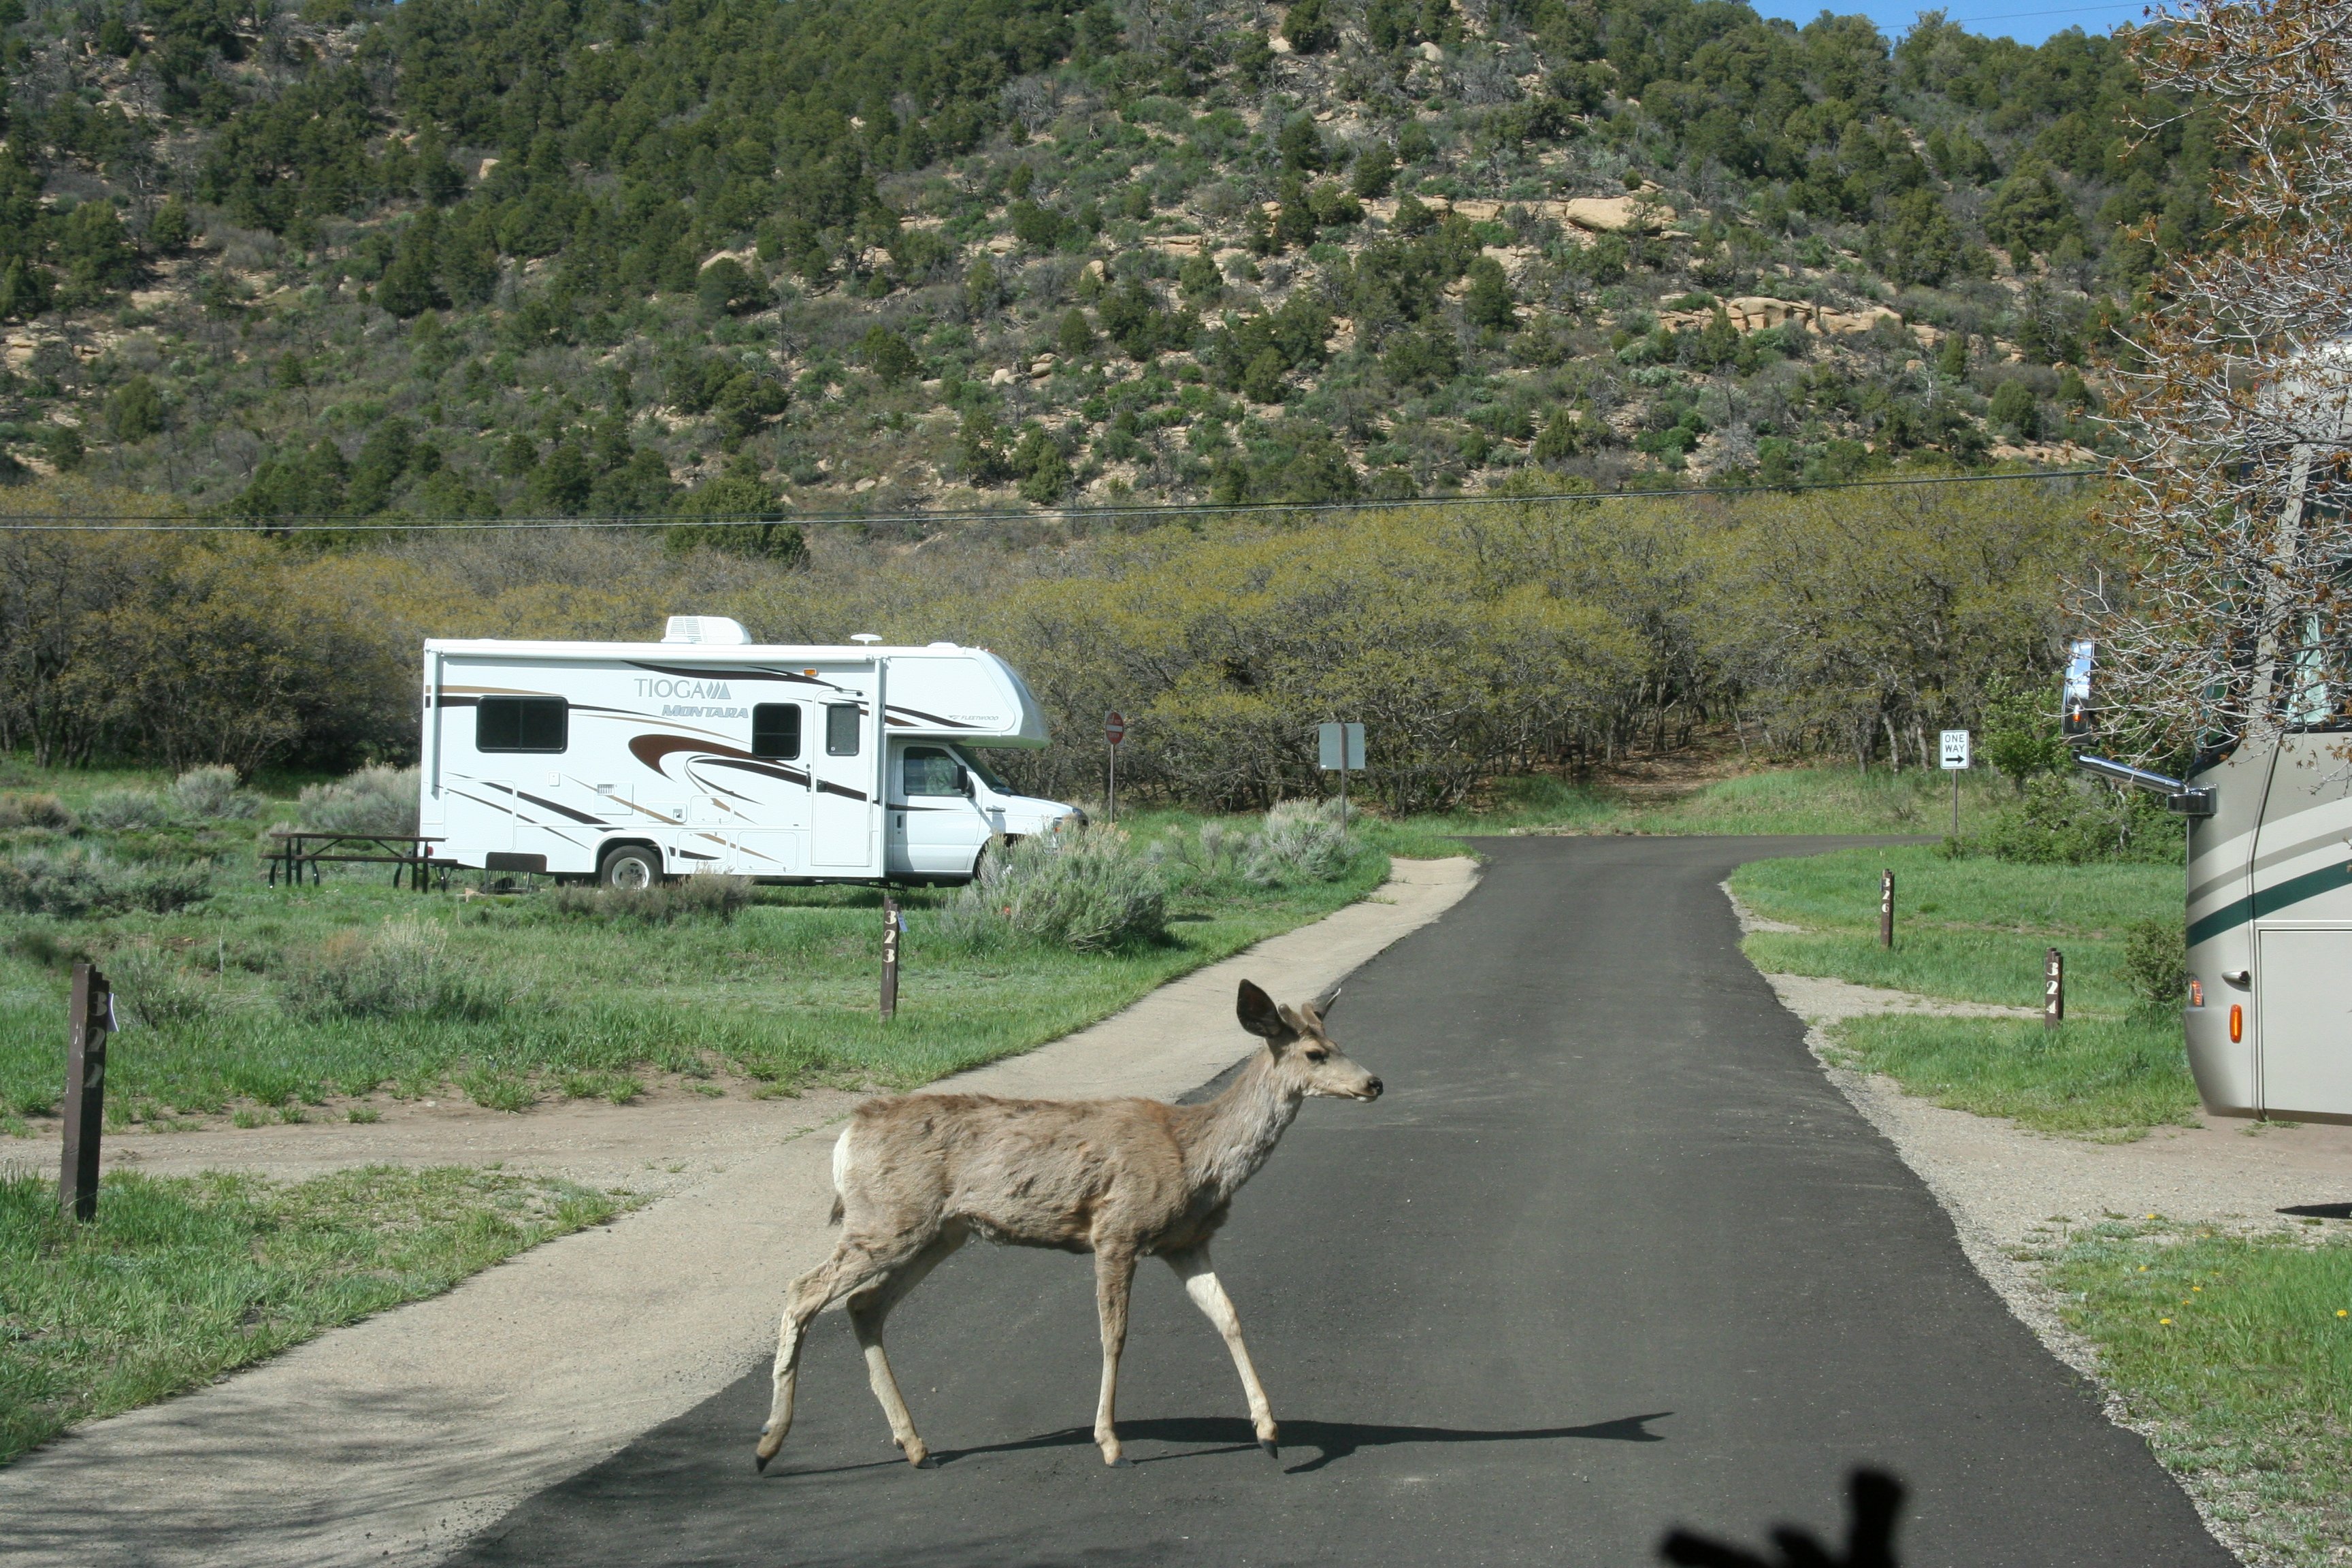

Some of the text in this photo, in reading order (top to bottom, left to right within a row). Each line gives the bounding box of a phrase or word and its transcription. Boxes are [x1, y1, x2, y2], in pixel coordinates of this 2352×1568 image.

[634, 679, 706, 699] TIOGA
[662, 704, 749, 718] MONTARA
[1944, 734, 1965, 742] ONE
[1945, 744, 1965, 753] WAY
[1881, 877, 1891, 913] 326
[883, 911, 896, 962] 323
[2046, 962, 2059, 1014] 324
